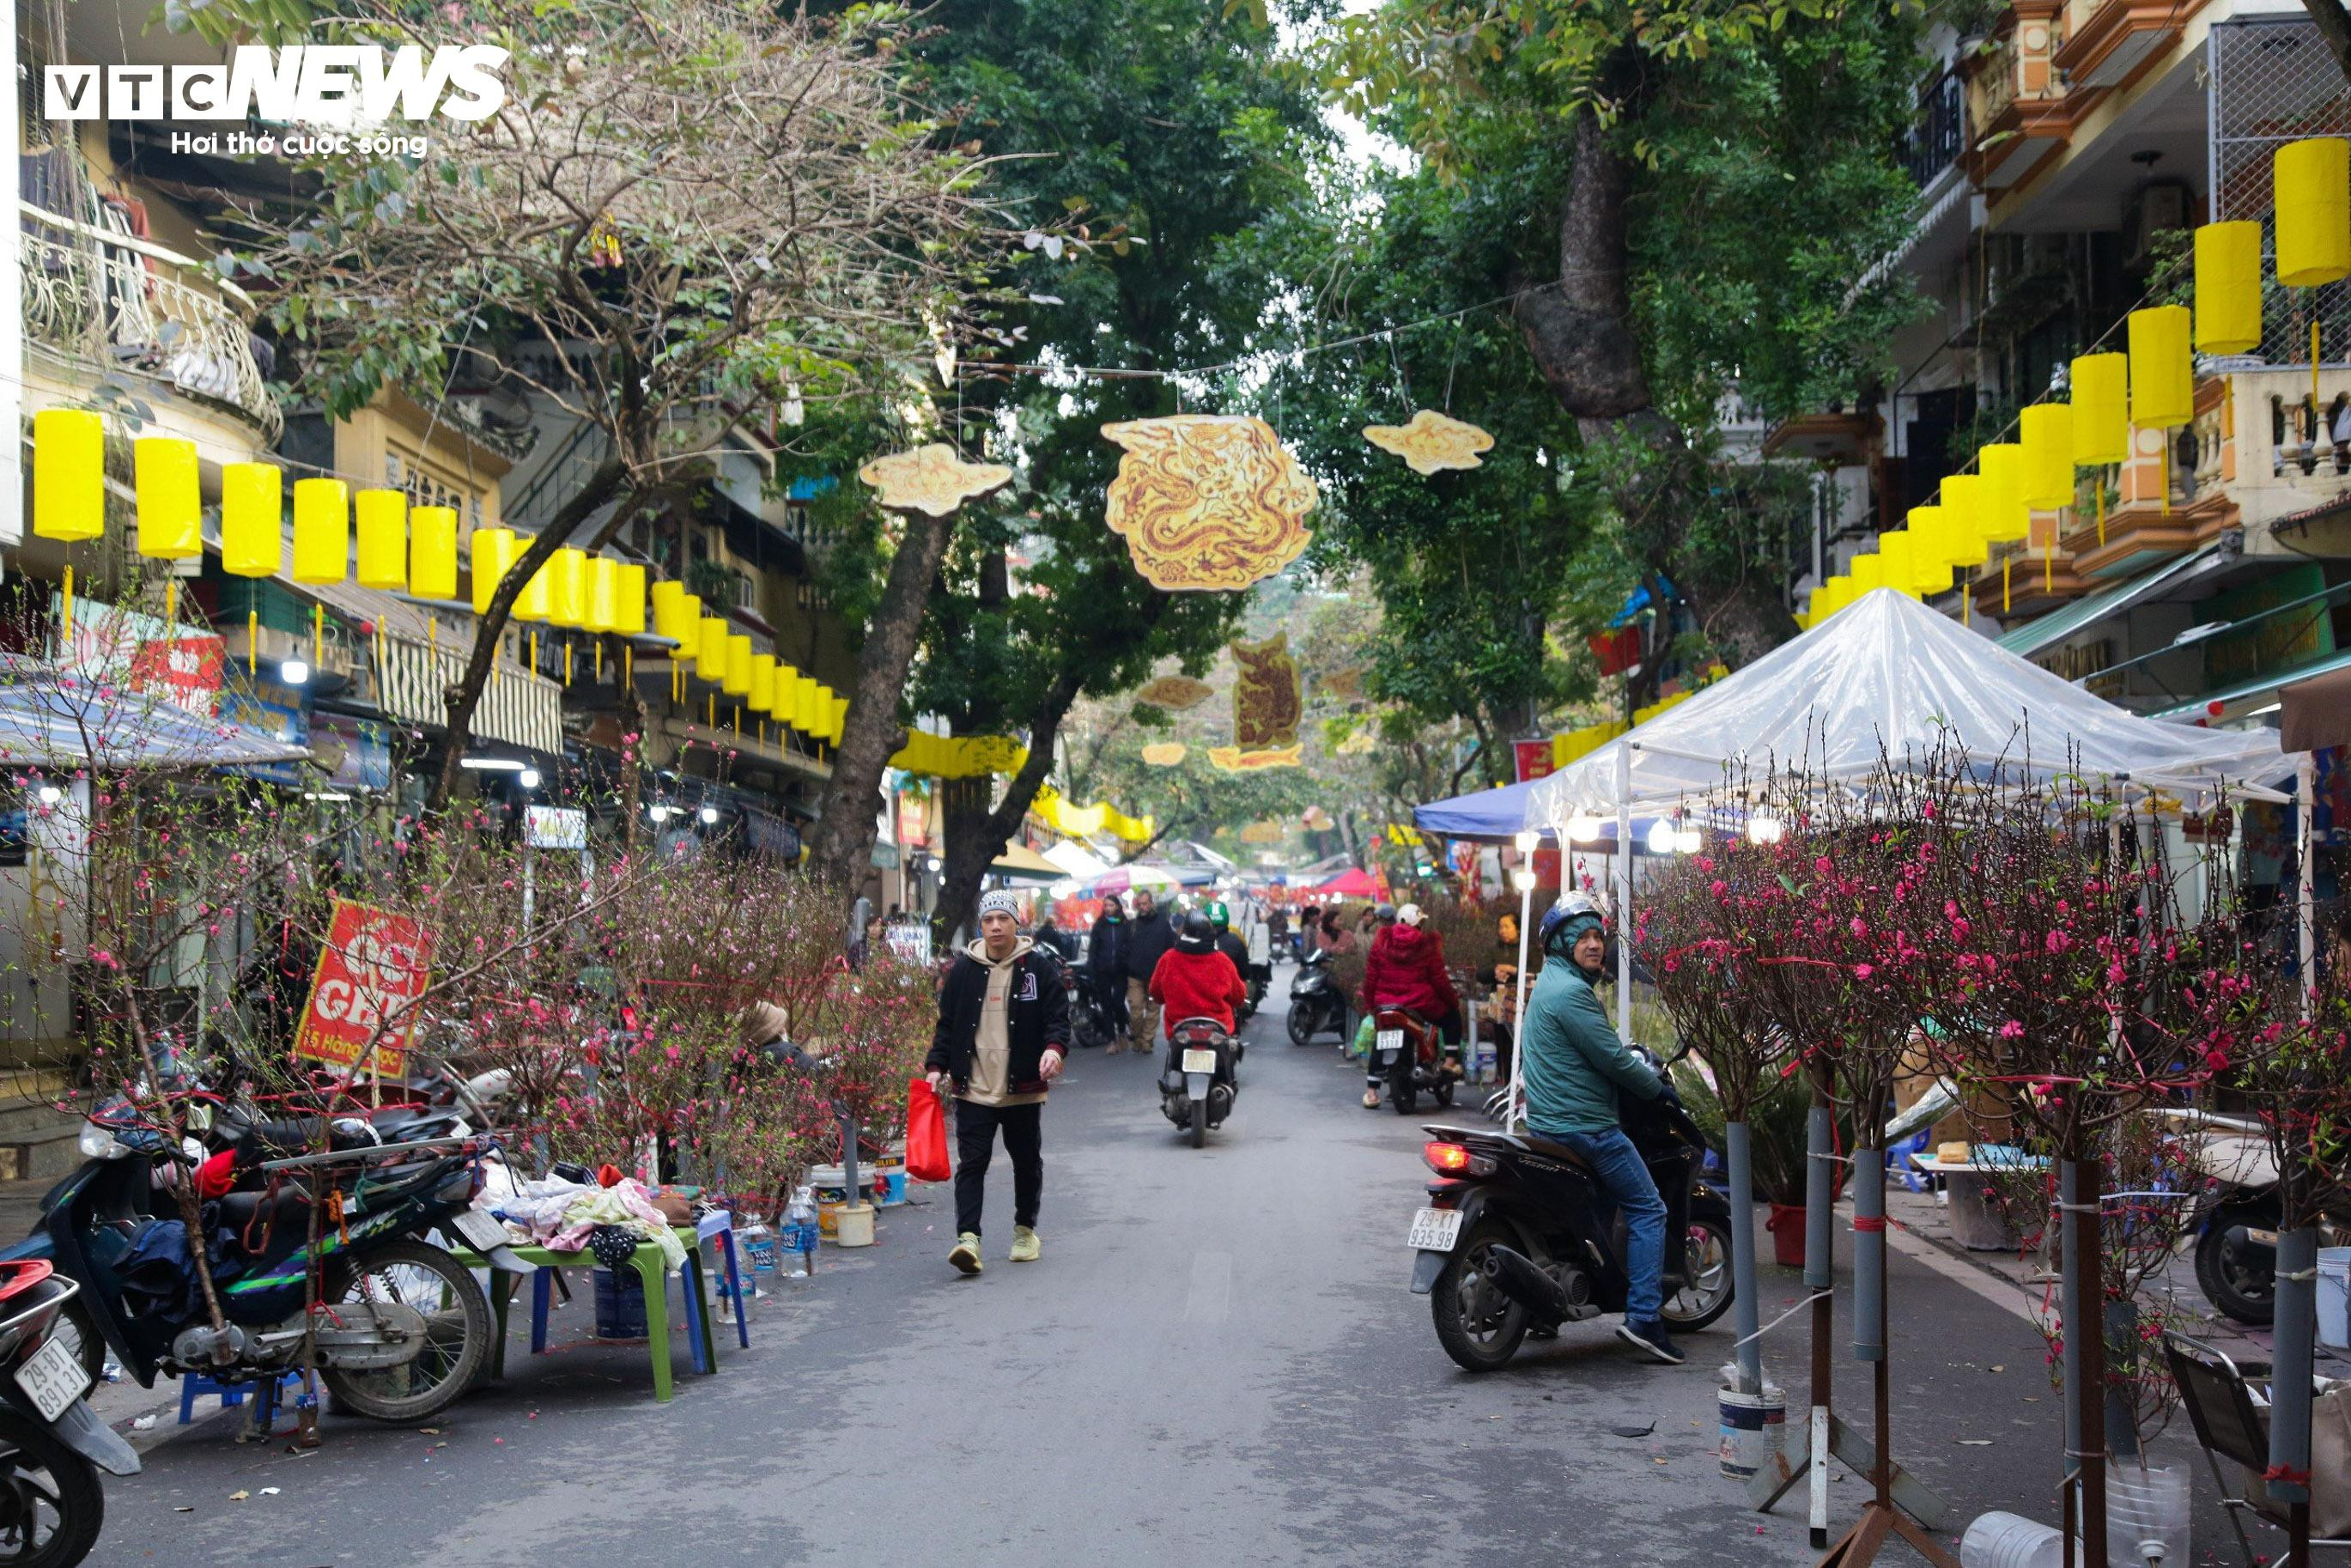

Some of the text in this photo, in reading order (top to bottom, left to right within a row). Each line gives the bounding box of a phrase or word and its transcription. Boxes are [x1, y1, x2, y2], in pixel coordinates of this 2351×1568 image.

[1418, 1211, 1455, 1229] 29-K1
[1410, 1229, 1454, 1249] 935.98
[24, 1345, 65, 1391] 29-B1
[38, 1364, 86, 1415] 891.31
